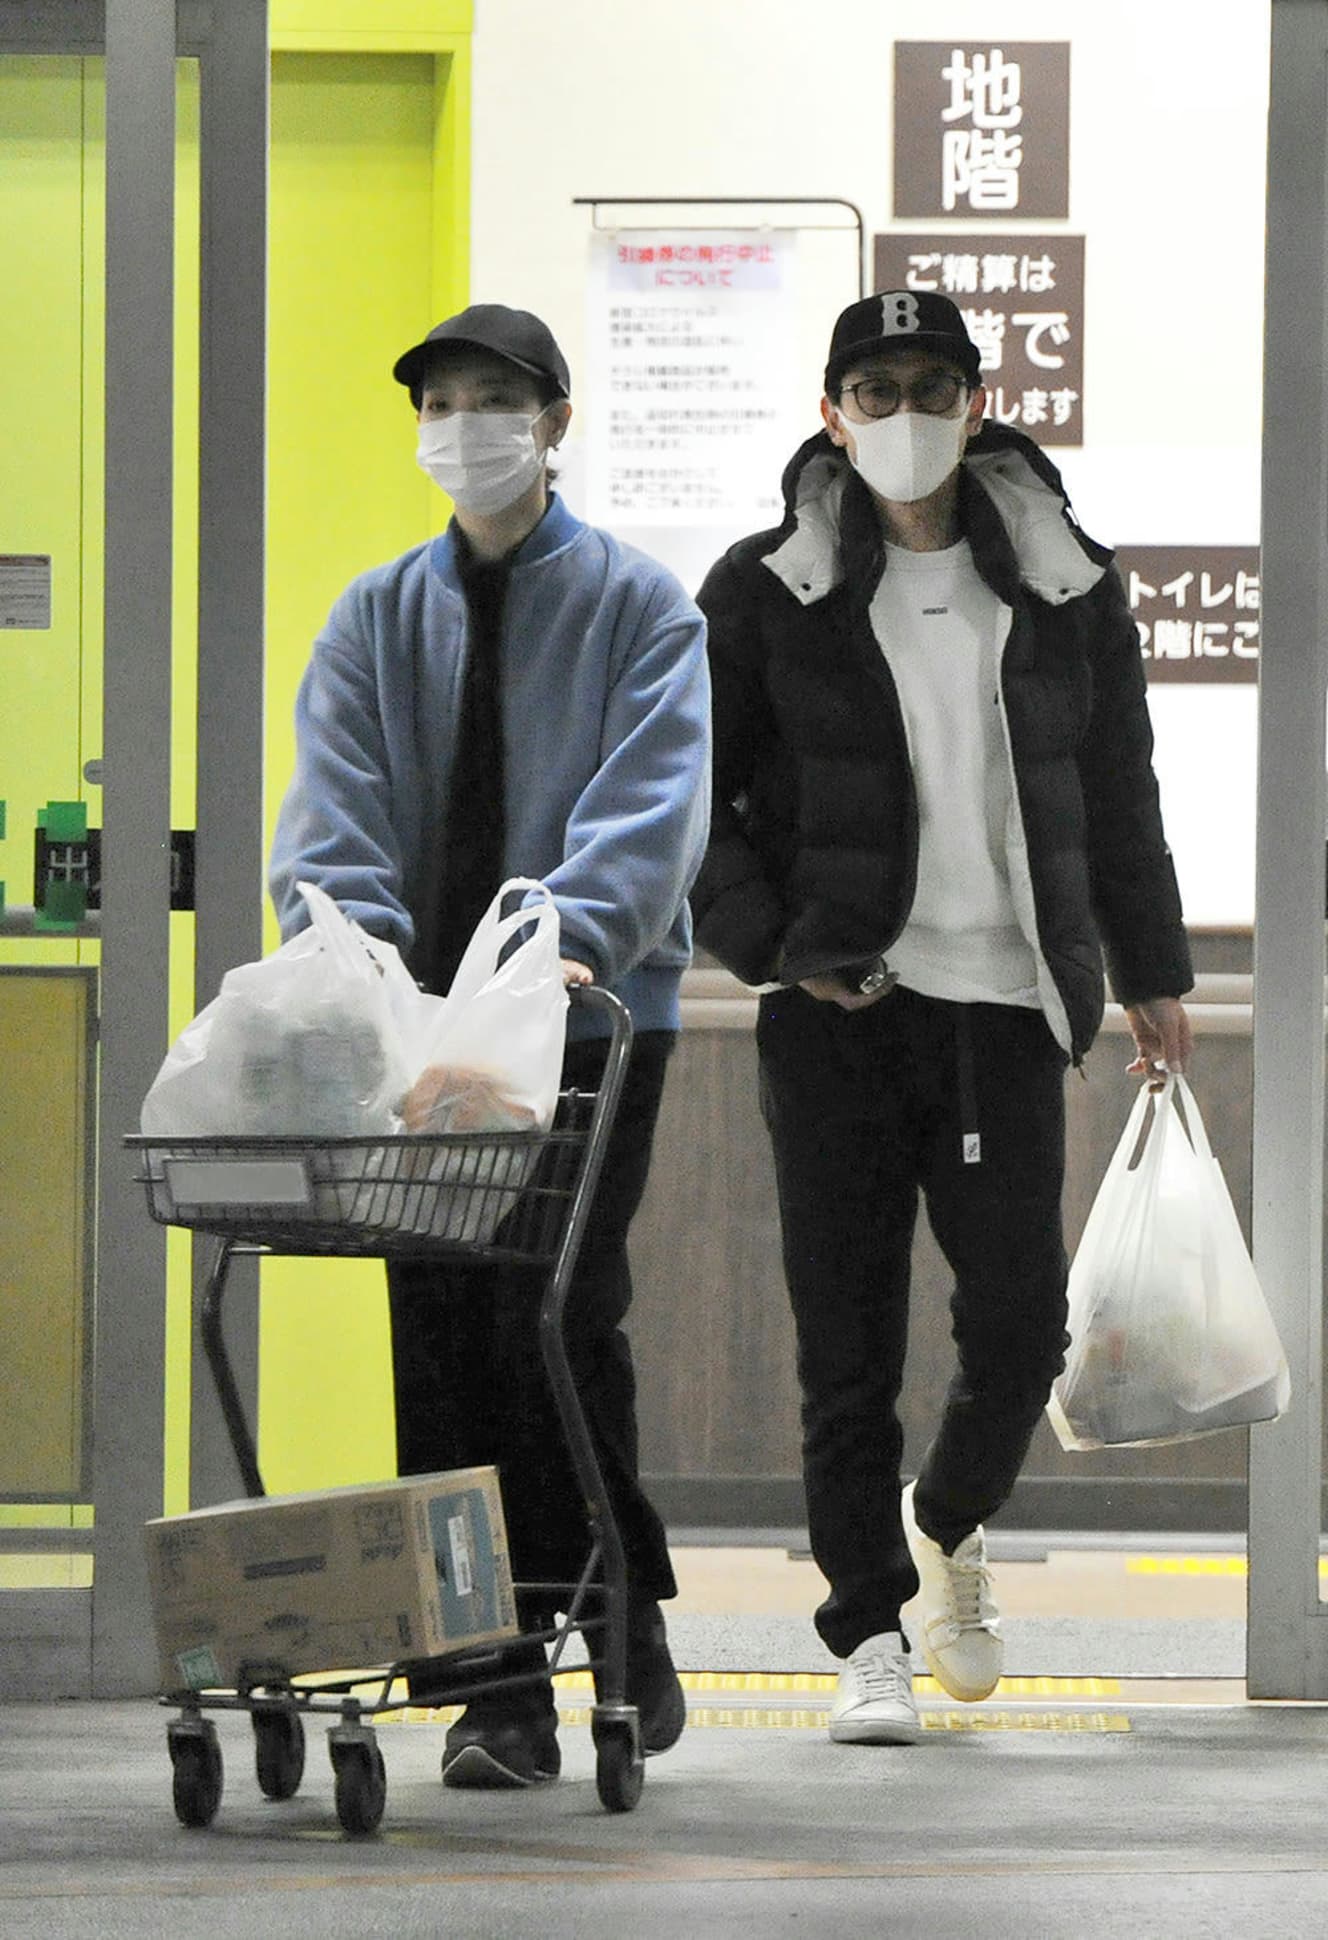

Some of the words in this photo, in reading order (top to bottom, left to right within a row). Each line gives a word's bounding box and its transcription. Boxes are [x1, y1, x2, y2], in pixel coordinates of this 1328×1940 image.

[941, 48, 1023, 211] 地階
[905, 253, 1056, 294] ご精算は
[880, 292, 920, 337] B
[1128, 570, 1259, 609] トイレは
